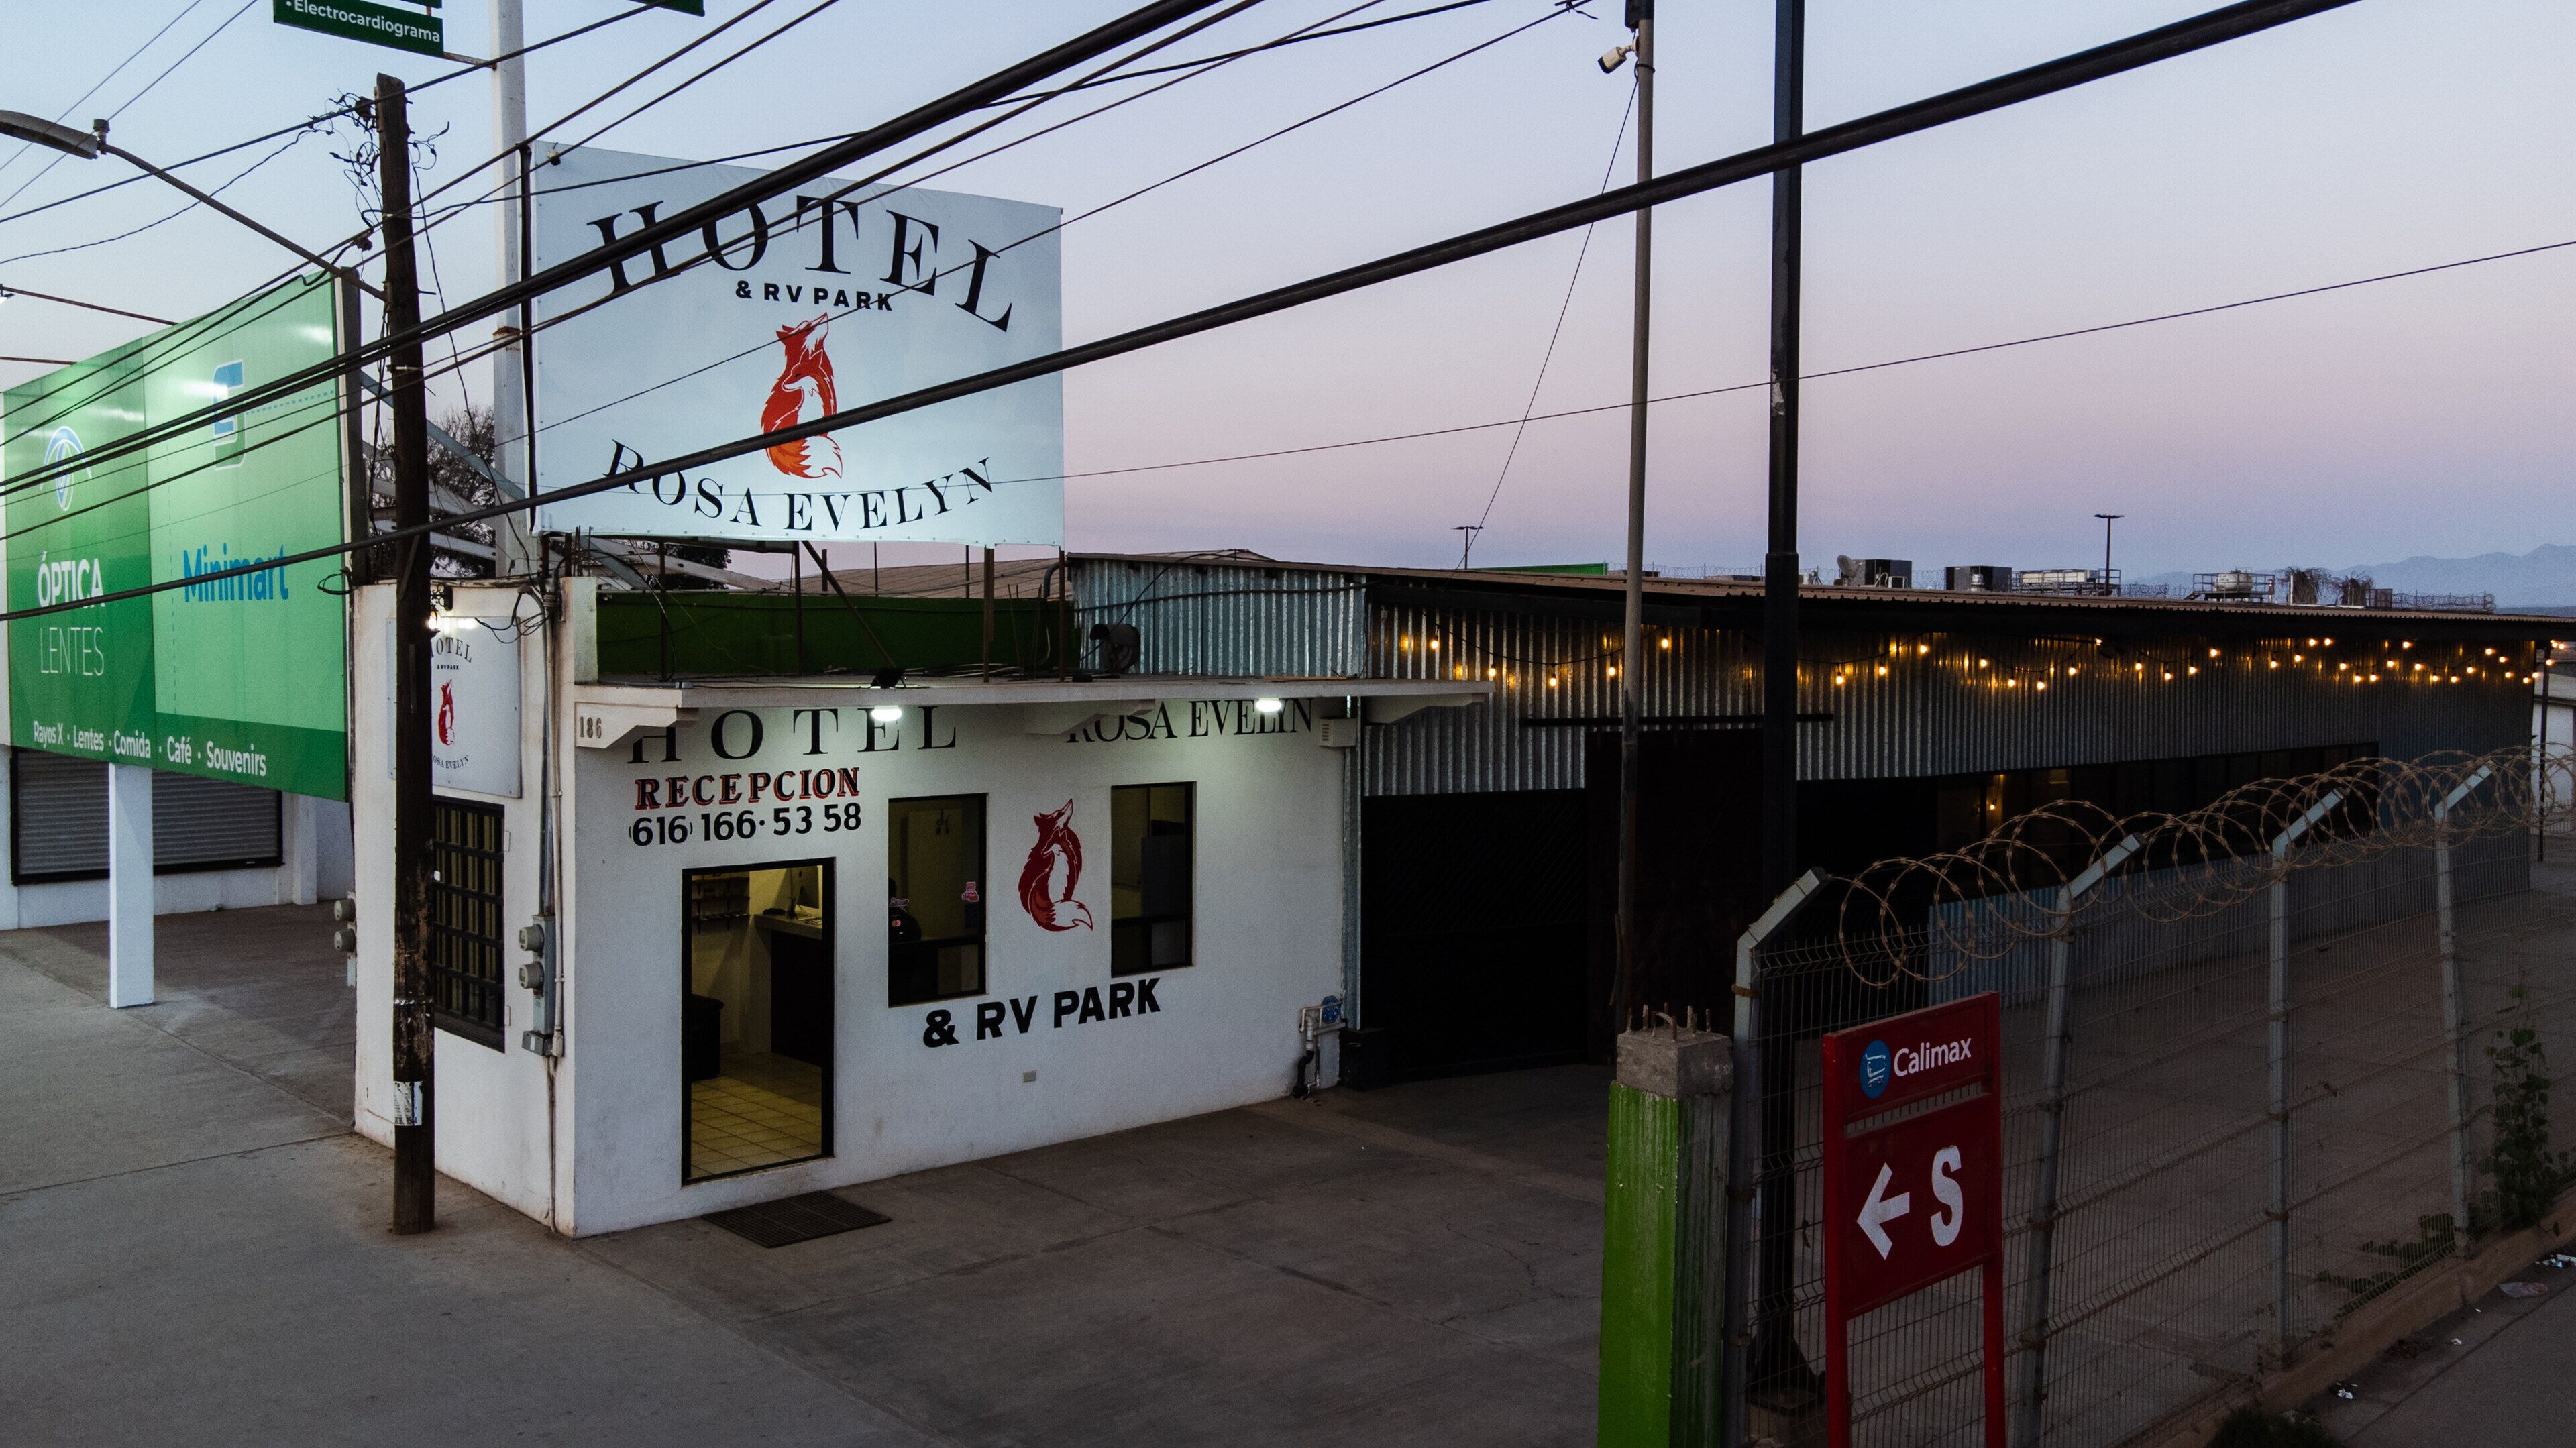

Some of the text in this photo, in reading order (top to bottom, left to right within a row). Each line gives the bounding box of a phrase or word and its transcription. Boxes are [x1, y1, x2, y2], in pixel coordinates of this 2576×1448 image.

[294, 0, 440, 42] Electrocardiograma
[587, 194, 1012, 332] HOTEL
[736, 280, 893, 311] & RV PARK
[604, 439, 996, 531] ROSA EVELYN
[38, 551, 105, 608] ÓPTICA
[184, 542, 288, 602] Minimart
[40, 627, 105, 676] LENTES
[431, 637, 472, 663] OTEL
[34, 720, 266, 777] Rayos X Lentes Comida Café Souvenirs
[579, 716, 602, 739] 186
[445, 755, 469, 769] EVELYN
[635, 767, 860, 811] RECEPCION
[628, 814, 693, 847] (616)
[824, 802, 861, 832] 58
[922, 977, 1161, 1048] & RV PARK
[1894, 1037, 1972, 1078] Calimax
[1931, 1144, 1963, 1247] S
